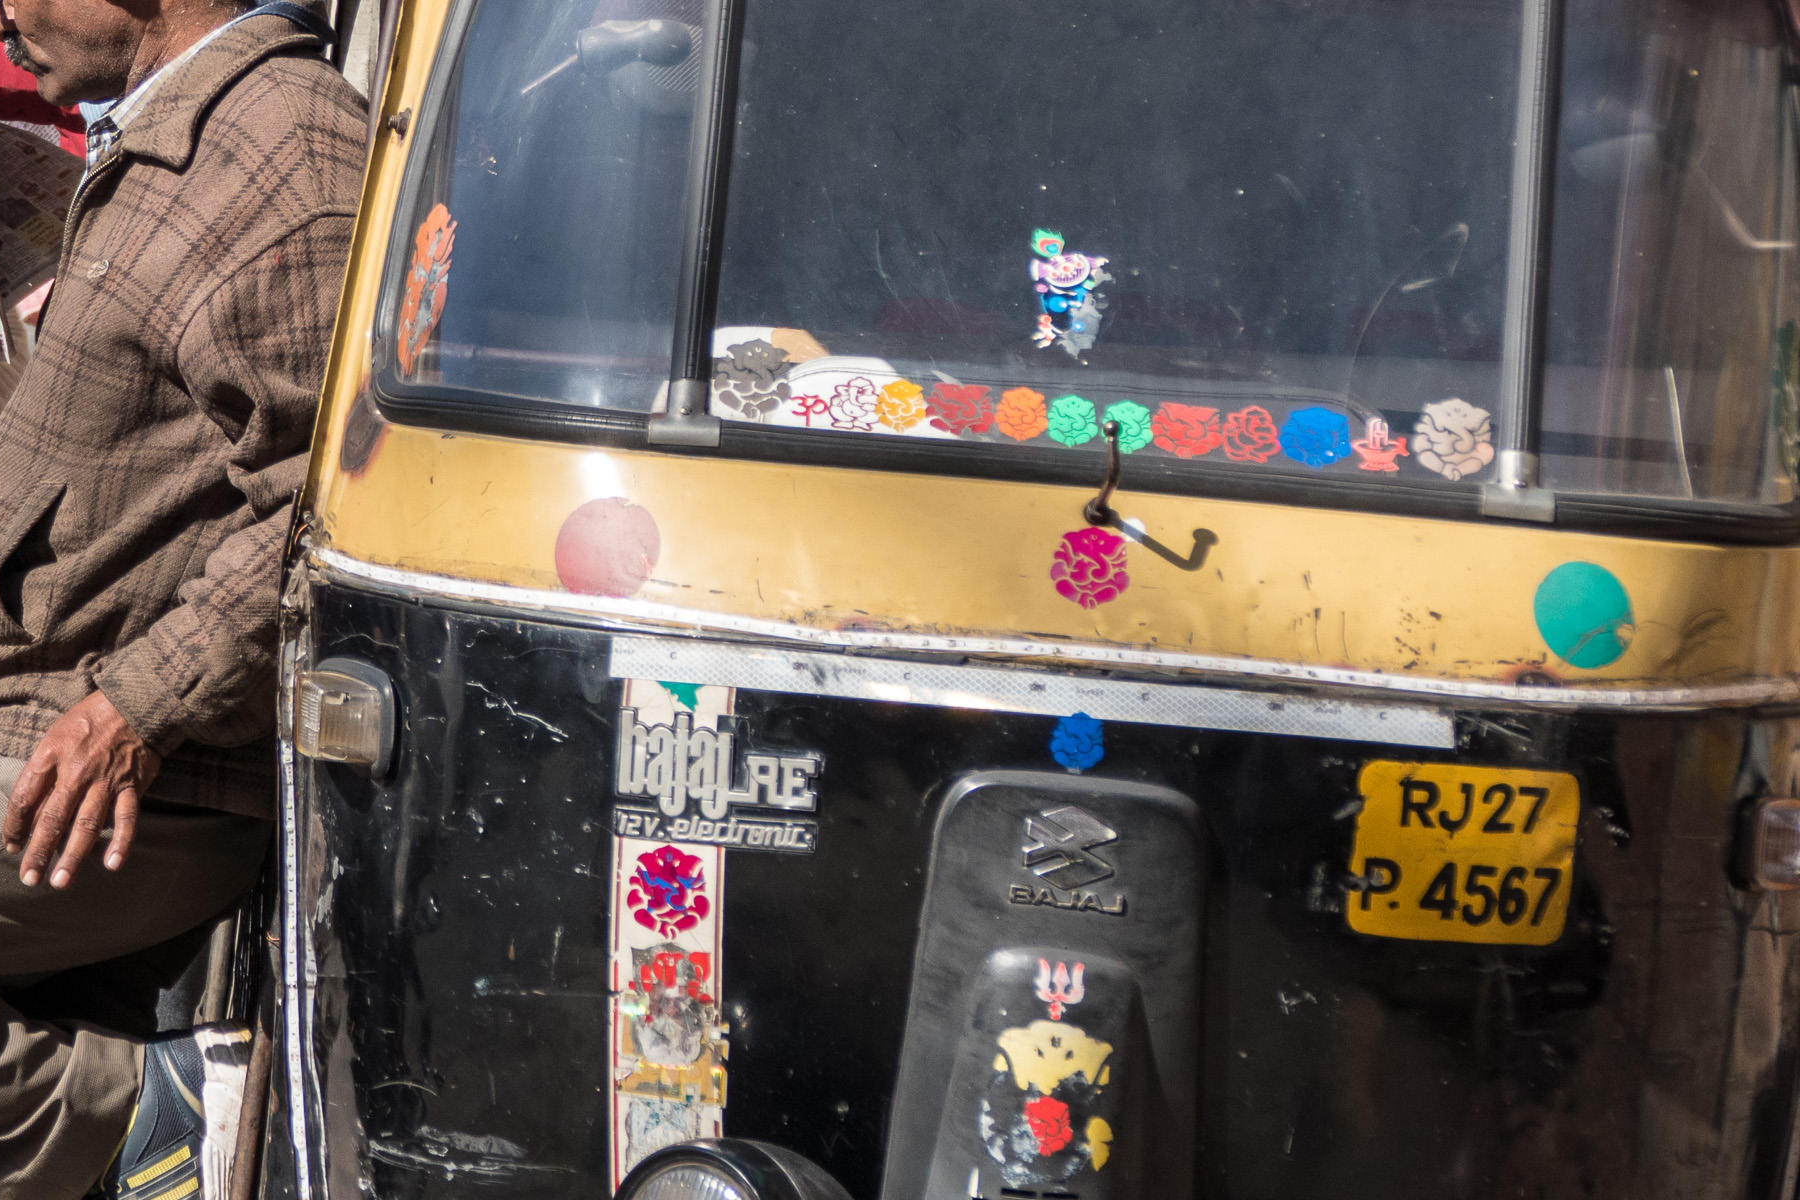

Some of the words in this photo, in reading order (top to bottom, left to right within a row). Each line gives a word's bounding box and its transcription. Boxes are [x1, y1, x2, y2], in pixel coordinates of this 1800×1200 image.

[617, 708, 733, 820] bajaj
[1009, 883, 1125, 915] BAJAJ
[1419, 862, 1563, 927] 4567
